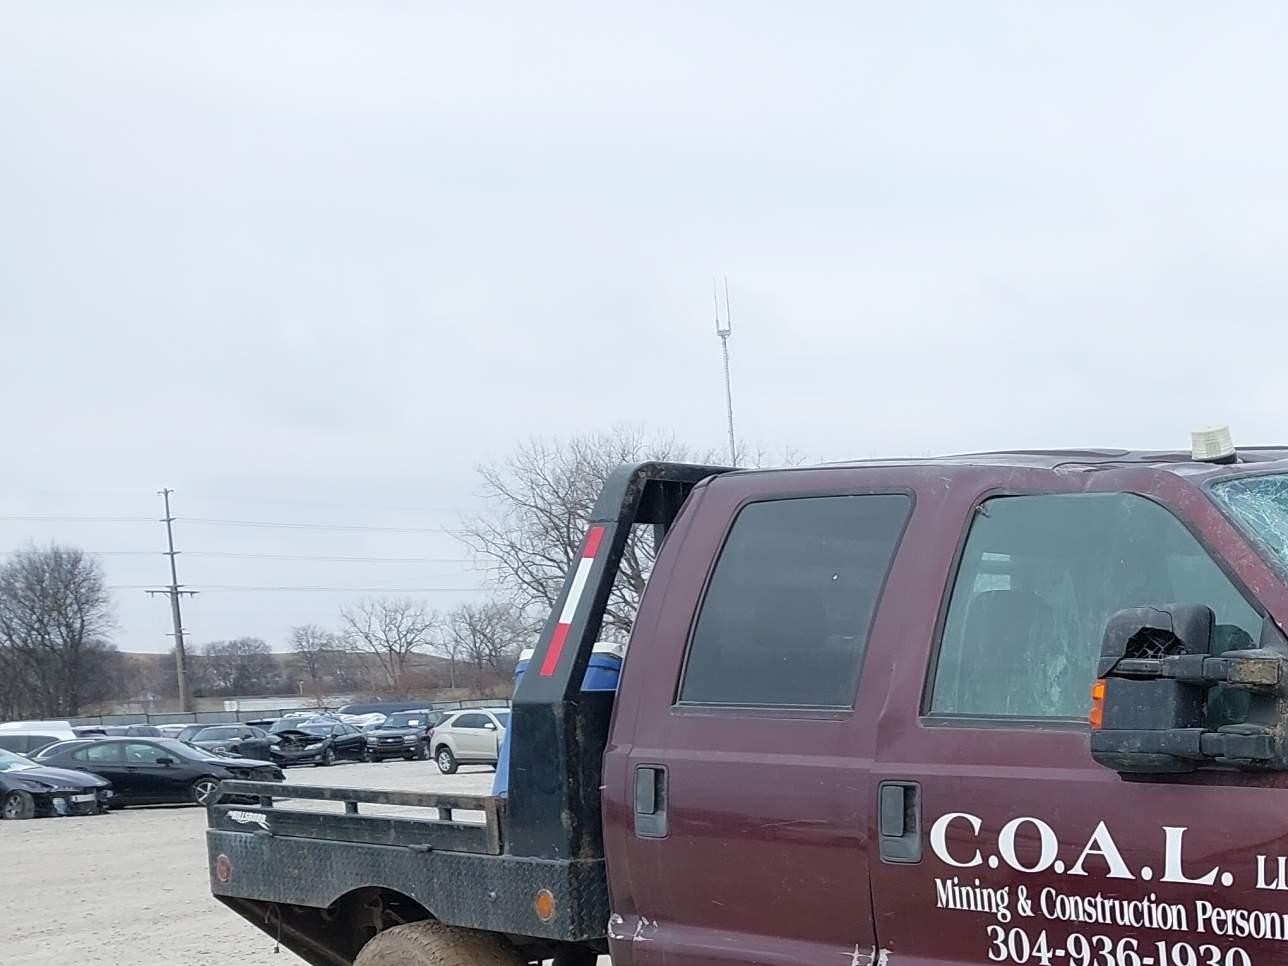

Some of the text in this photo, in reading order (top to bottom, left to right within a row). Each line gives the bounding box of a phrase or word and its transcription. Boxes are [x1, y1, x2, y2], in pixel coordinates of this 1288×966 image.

[929, 811, 1234, 888] C.O.A.L.
[934, 878, 1010, 923] Mining
[1017, 885, 1036, 918] &
[1040, 887, 1188, 932] Construction
